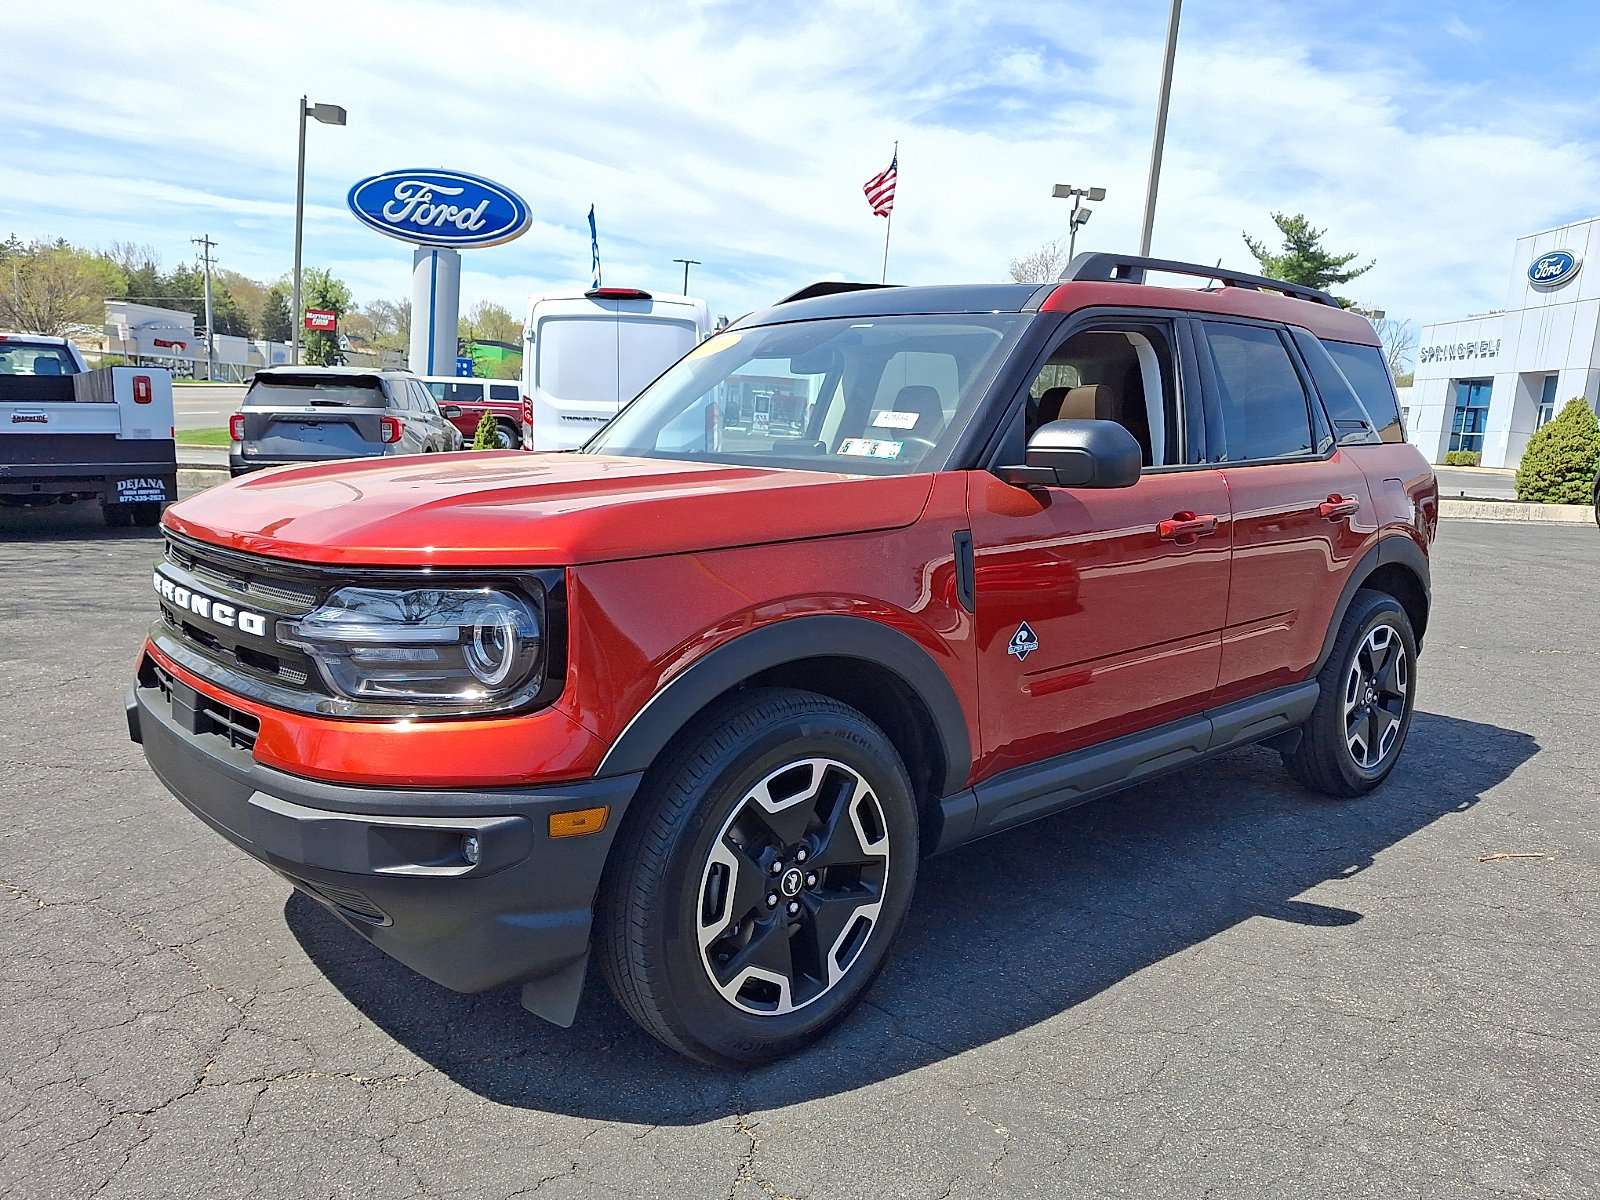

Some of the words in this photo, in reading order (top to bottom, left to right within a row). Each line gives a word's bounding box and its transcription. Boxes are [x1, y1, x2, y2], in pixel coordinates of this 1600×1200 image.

[382, 180, 491, 231] Ford
[1534, 256, 1565, 279] Ford
[116, 478, 166, 491] DEJANA
